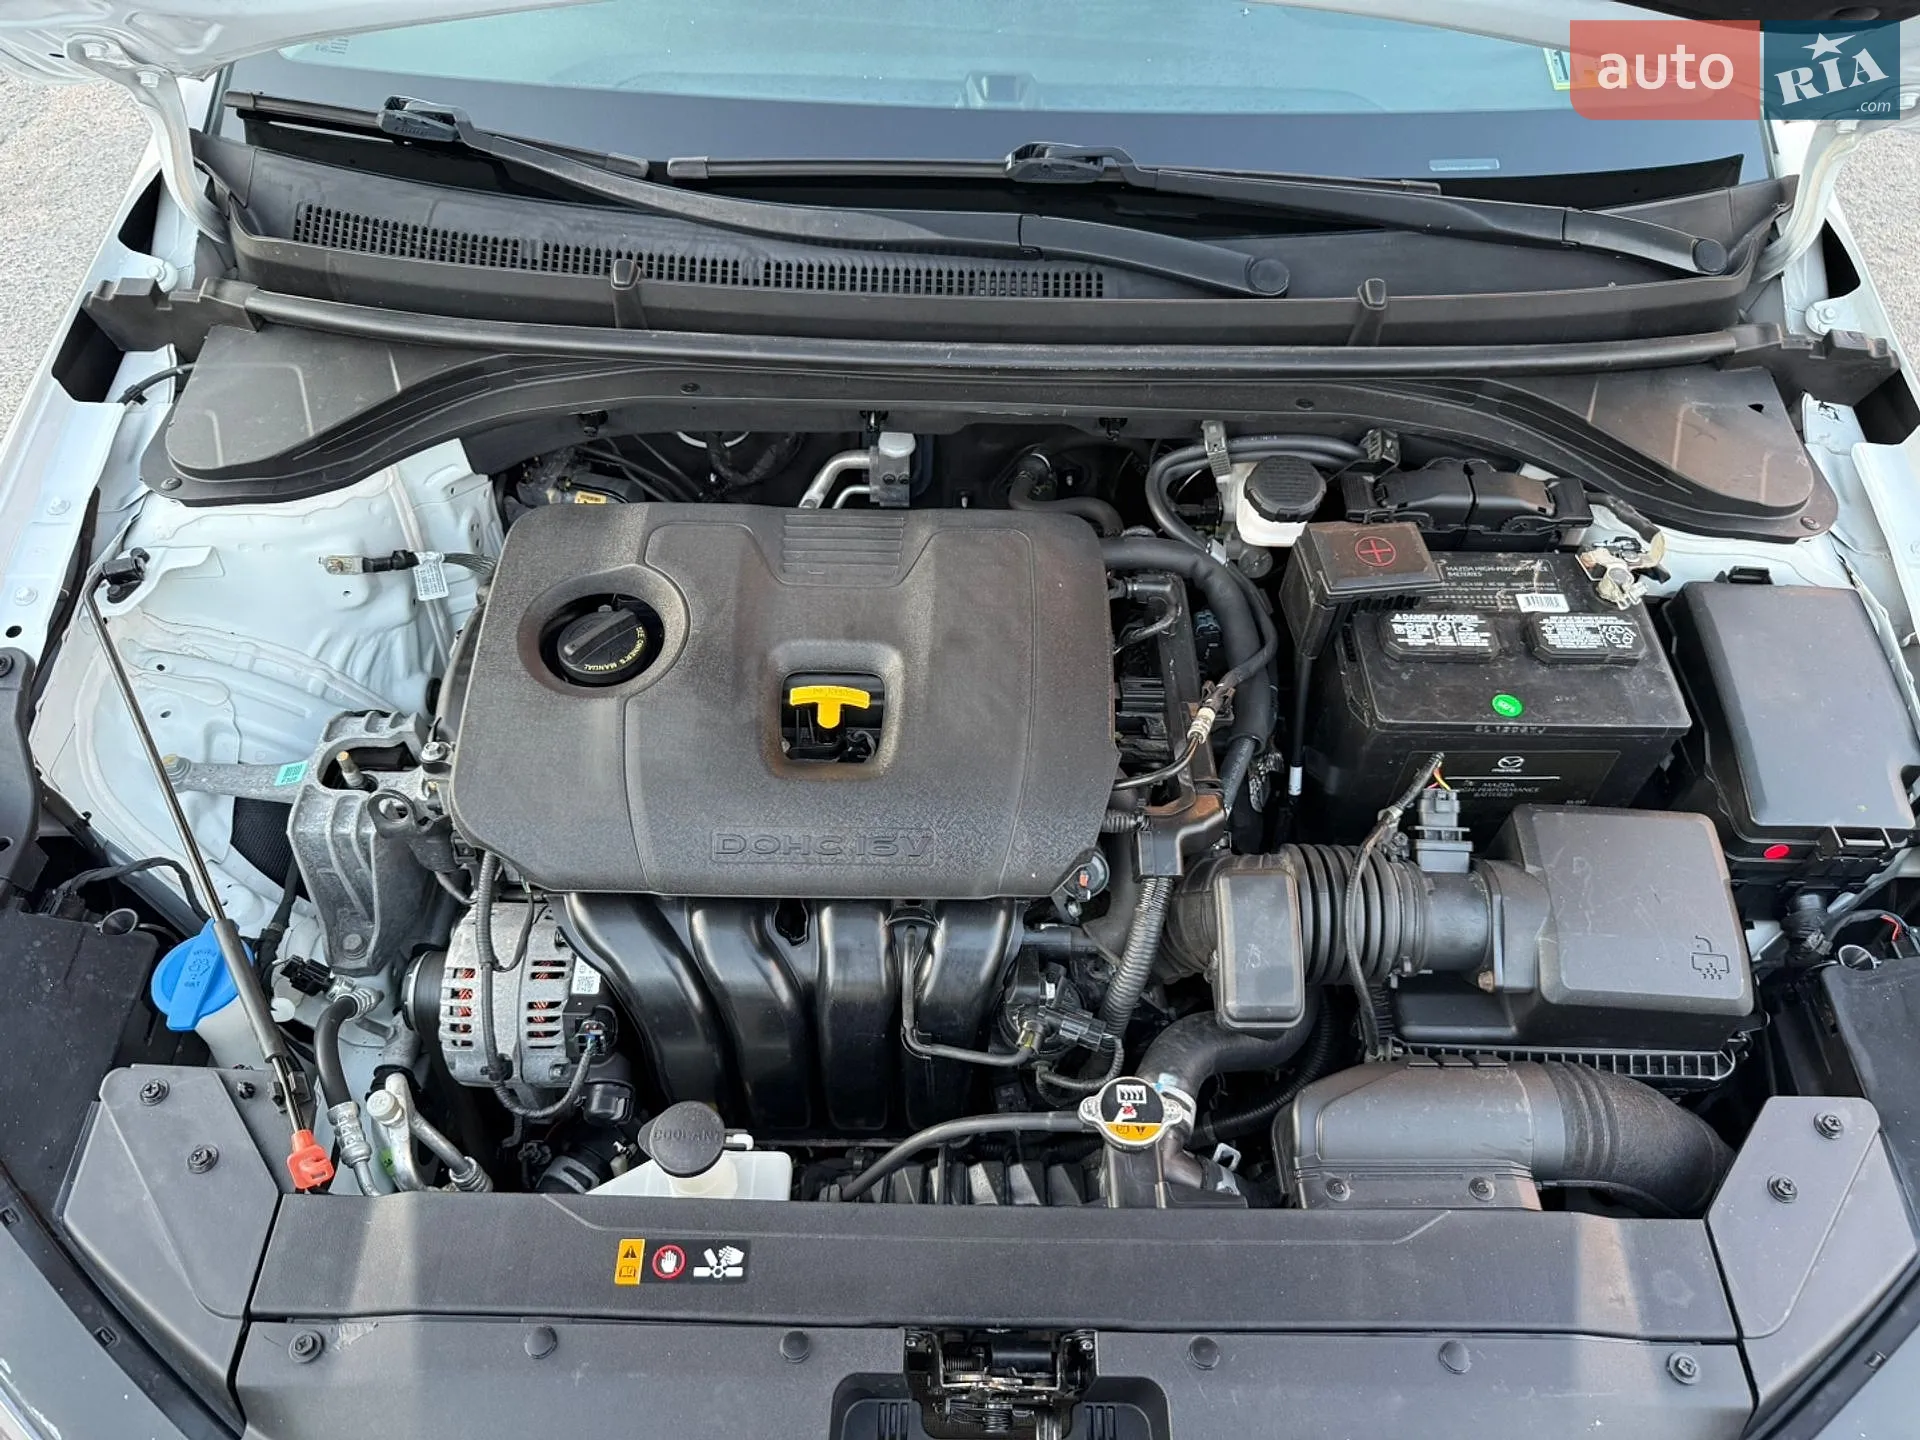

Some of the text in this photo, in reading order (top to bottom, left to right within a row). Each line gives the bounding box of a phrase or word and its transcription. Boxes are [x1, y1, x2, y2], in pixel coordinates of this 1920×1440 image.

[714, 833, 930, 858] DOHC 16V
[653, 1128, 720, 1143] COOLANT
